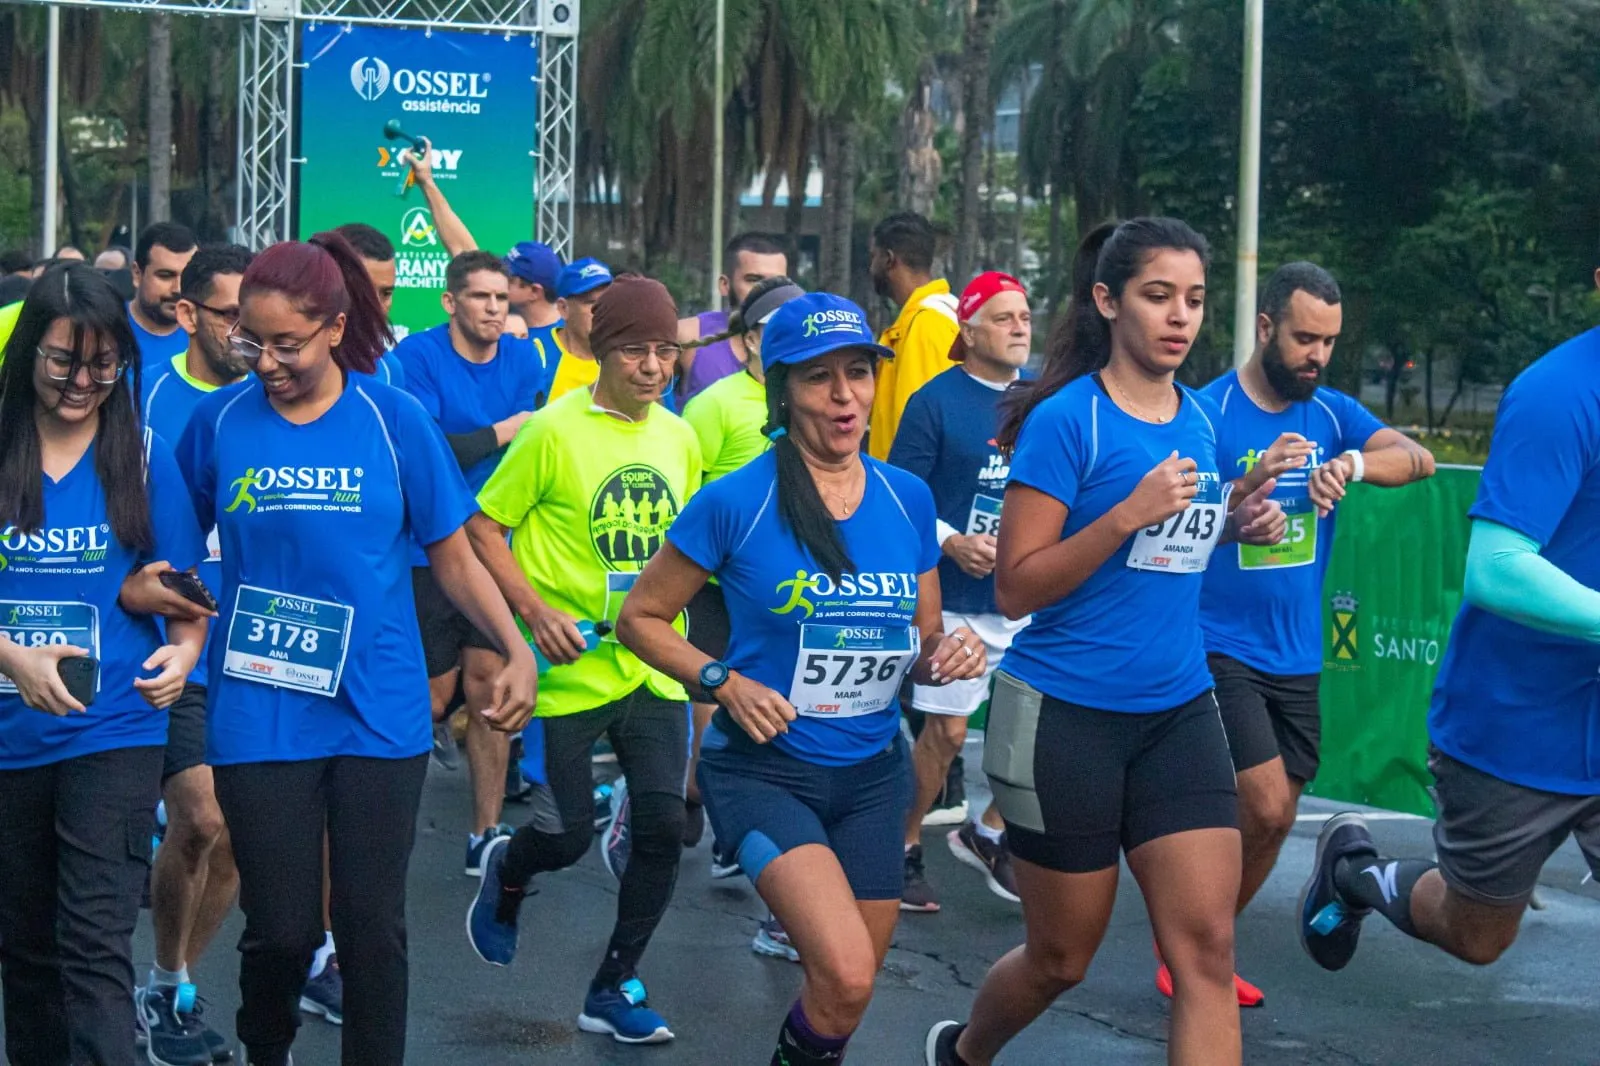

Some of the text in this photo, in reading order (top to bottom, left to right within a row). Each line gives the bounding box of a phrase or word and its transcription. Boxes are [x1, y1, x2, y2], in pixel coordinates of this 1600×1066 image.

[393, 69, 487, 98] OSSEL
[402, 98, 480, 114] assistência
[429, 149, 463, 170] RY
[394, 251, 449, 260] NSTITUTO
[395, 259, 450, 277] RANY
[394, 276, 448, 289] ARCHETT
[813, 310, 862, 324] OSSEL
[254, 466, 361, 492] OSSEL
[621, 472, 654, 482] EQUIPE
[284, 503, 322, 511] CORRENDO
[323, 504, 340, 512] COM
[972, 513, 1000, 538] 58
[3, 526, 108, 553] OSSEL
[808, 572, 917, 599] OSSEL
[17, 605, 63, 617] OSSEL
[275, 596, 318, 616] OSSEL
[0, 631, 68, 648] 180
[247, 618, 320, 653] 3178
[844, 627, 884, 640] OSSEL
[268, 649, 289, 661] ANA
[1374, 633, 1439, 666] SANTO
[803, 654, 902, 687] 5736
[834, 690, 862, 699] MARIA
